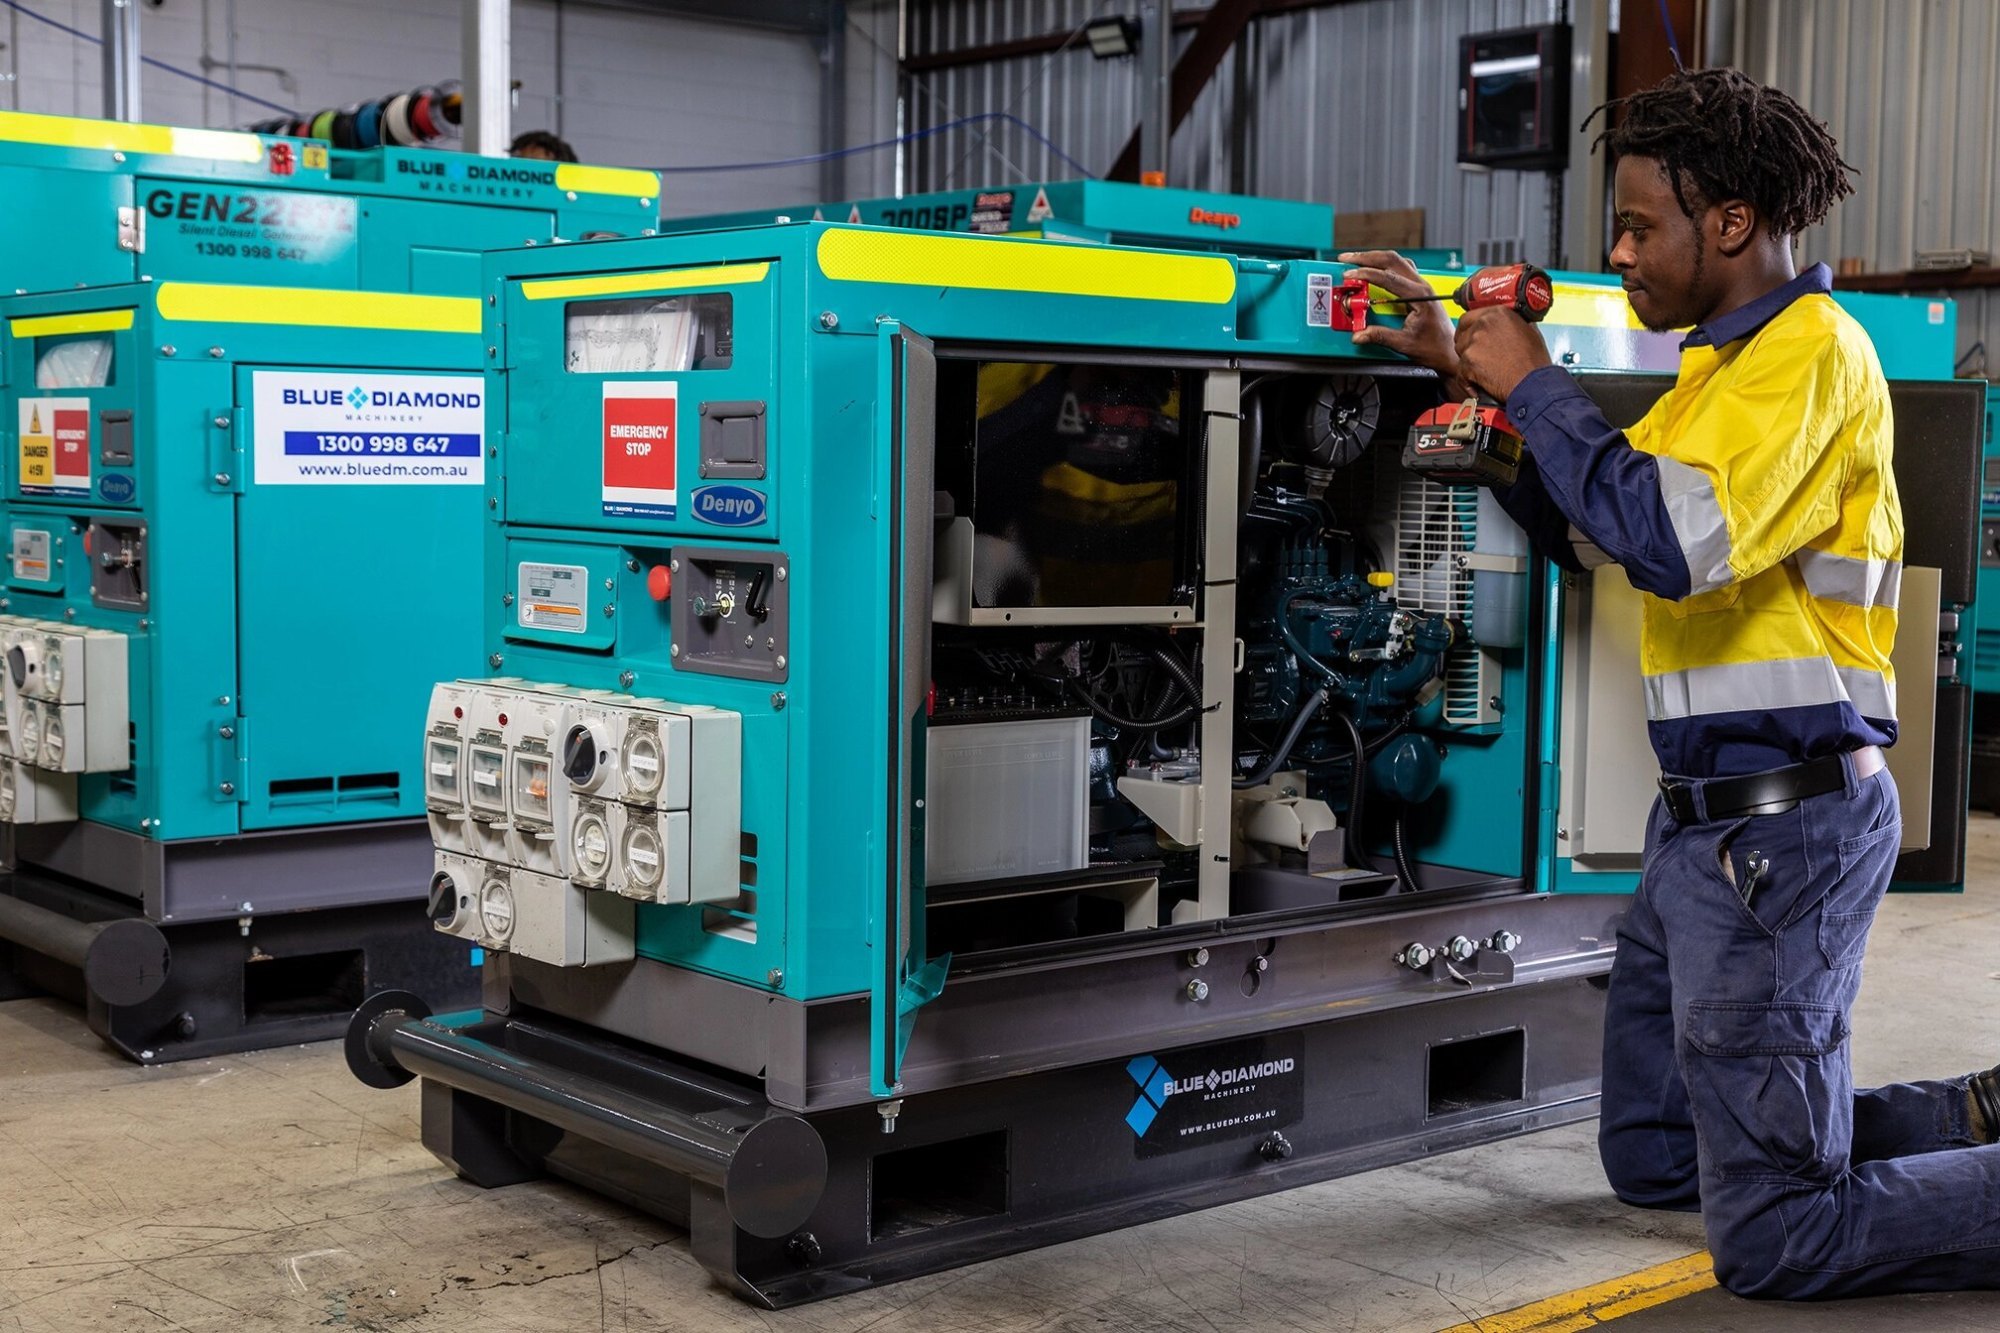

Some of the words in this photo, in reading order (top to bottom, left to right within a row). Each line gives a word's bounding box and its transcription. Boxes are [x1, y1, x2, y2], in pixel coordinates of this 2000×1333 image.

[397, 159, 445, 176] BLUE
[467, 165, 554, 186] DIAMOND
[419, 181, 534, 199] MACHINERY
[196, 241, 236, 257] 1300
[241, 244, 272, 259] 998
[1529, 282, 1551, 300] FUEL
[283, 389, 343, 405] BLUE
[372, 391, 481, 408] DIAMOND
[345, 414, 423, 422] MACHINERY
[610, 425, 668, 439] EMERGENCY
[1418, 433, 1437, 448] 5.0
[317, 434, 364, 452] 1300
[369, 436, 407, 453] 998
[412, 436, 450, 453] 647
[626, 443, 651, 456] STOP
[298, 463, 468, 477] www.bluedm.com.au
[103, 480, 130, 497] Denyo
[702, 494, 756, 518] Denyo
[1163, 1076, 1204, 1096] BLUE
[1221, 1058, 1295, 1084] DIAMOND
[1203, 1085, 1256, 1101] MACHINERY
[1179, 1109, 1277, 1136] WWW.BLUEDM.COM.AU
